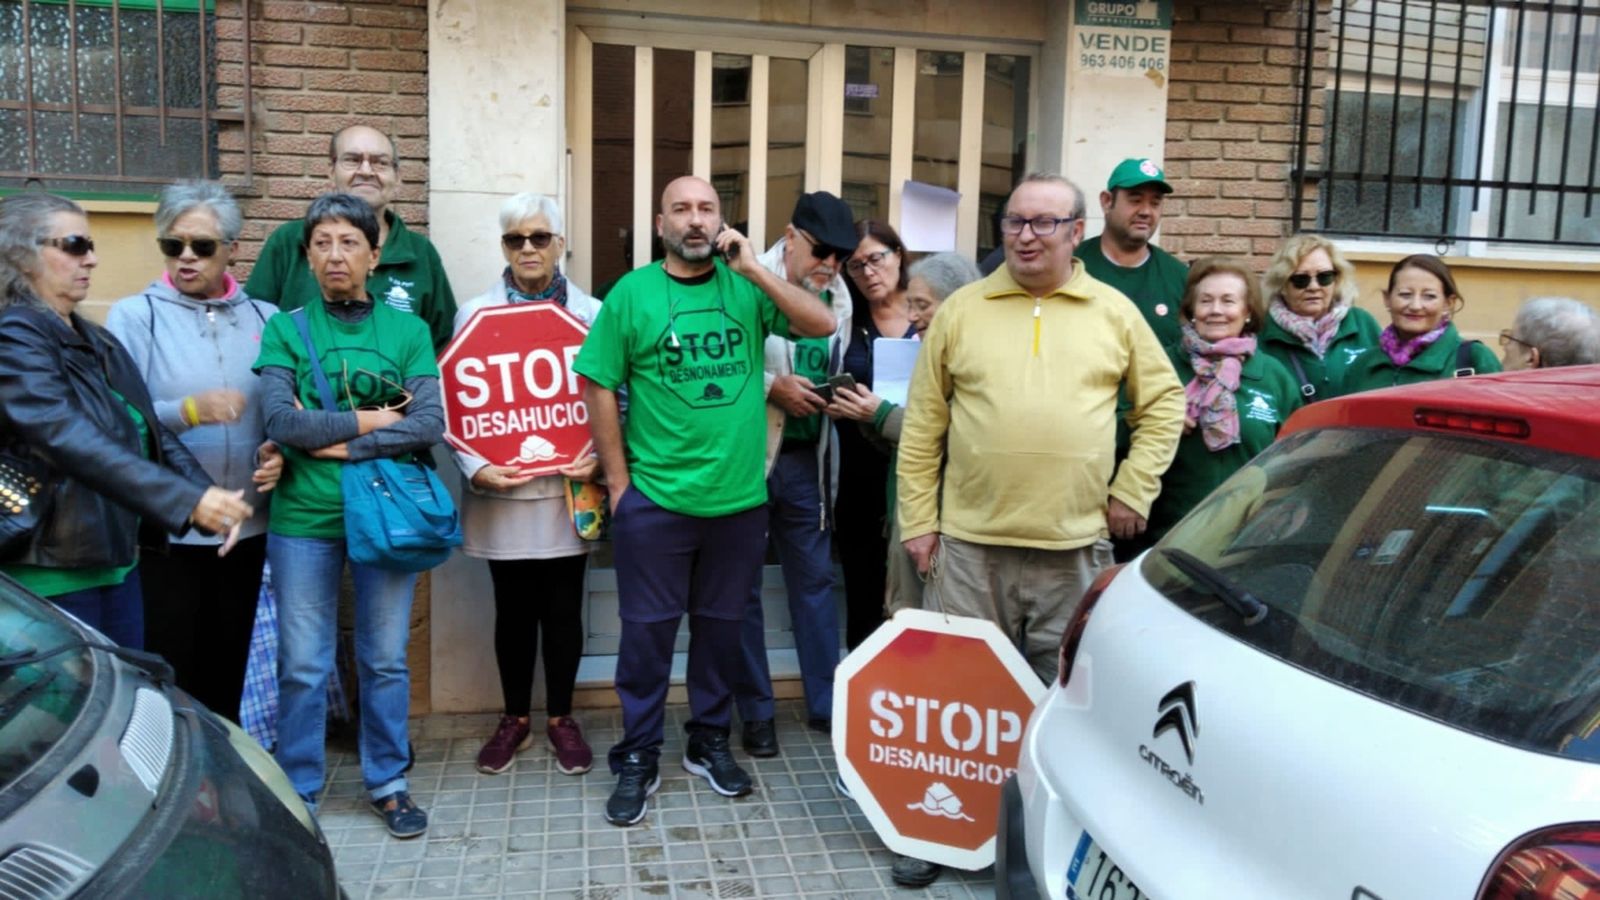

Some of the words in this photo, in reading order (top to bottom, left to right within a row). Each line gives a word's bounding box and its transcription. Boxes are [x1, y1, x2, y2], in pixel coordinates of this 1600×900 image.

[1087, 2, 1135, 16] GRUPO
[1079, 33, 1166, 53] VENDE
[1080, 54, 1105, 68] 963
[1109, 55, 1135, 69] 406
[1139, 57, 1165, 71] 406
[663, 328, 744, 366] STOP
[455, 345, 583, 408] STOP
[461, 400, 589, 440] DESAHUCIO
[869, 689, 1022, 756] STOP
